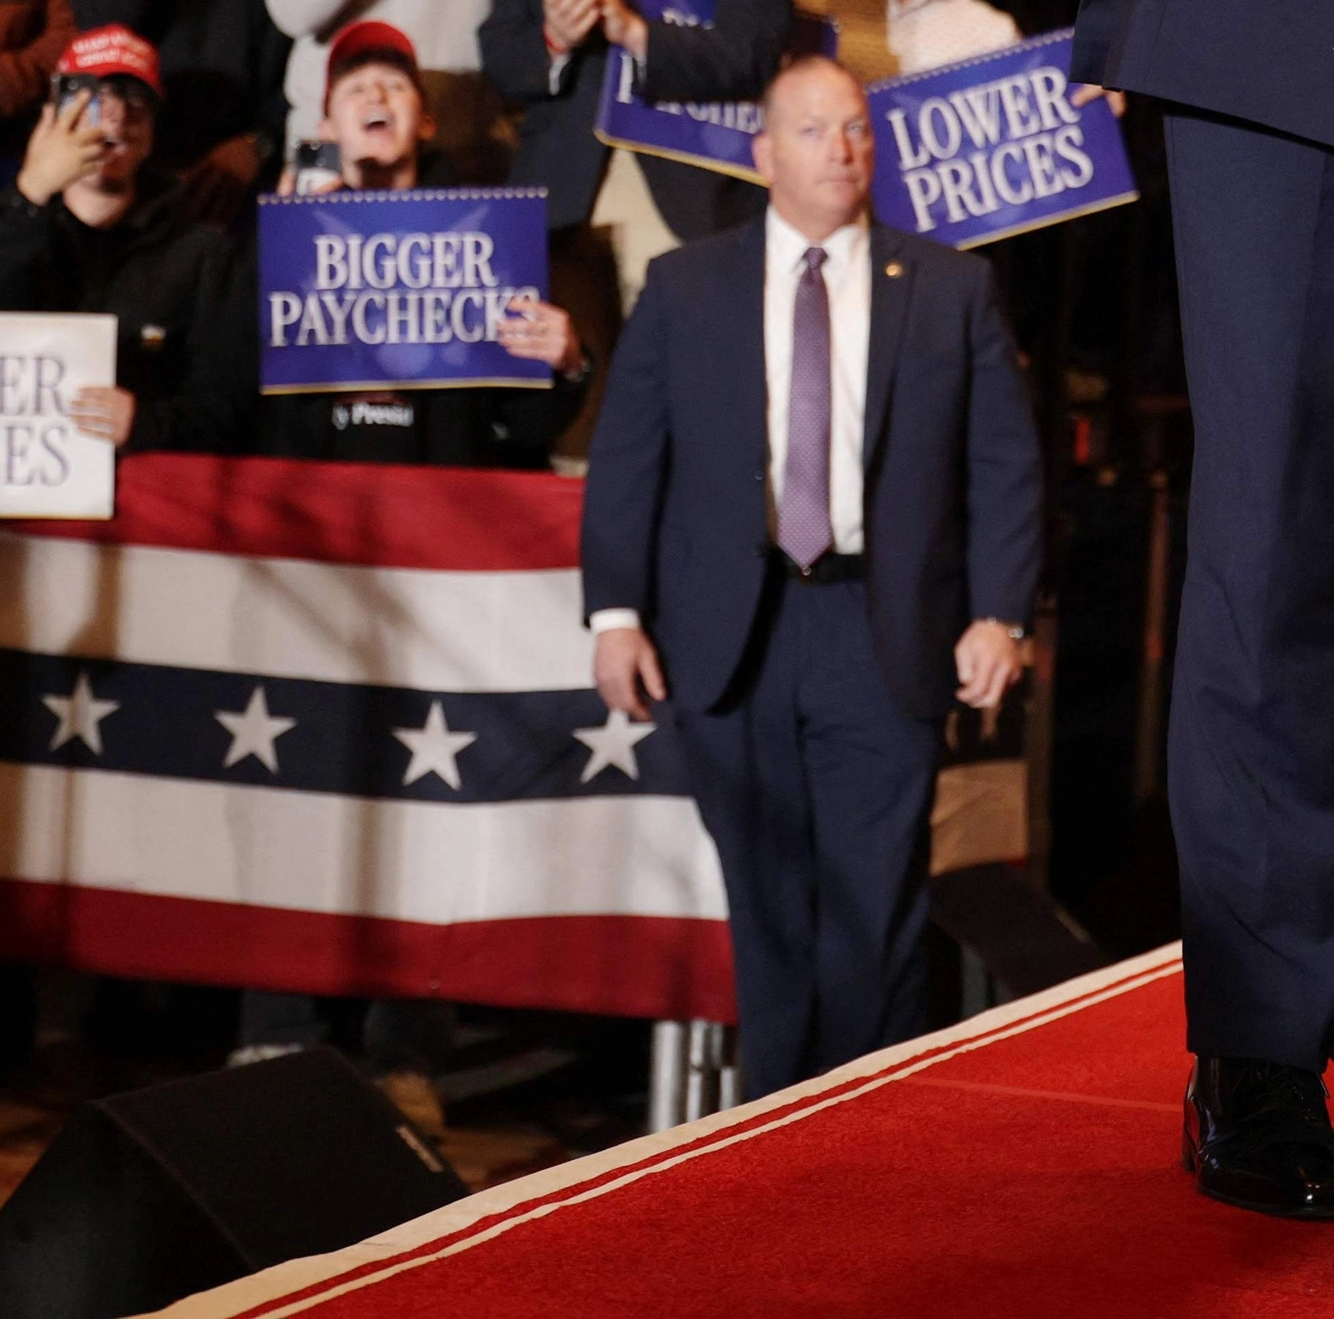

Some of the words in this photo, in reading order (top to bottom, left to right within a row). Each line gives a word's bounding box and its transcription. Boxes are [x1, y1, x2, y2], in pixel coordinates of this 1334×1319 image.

[886, 65, 1081, 172] LOWER
[903, 124, 1094, 233] PRICES
[314, 231, 499, 290] BIGGER
